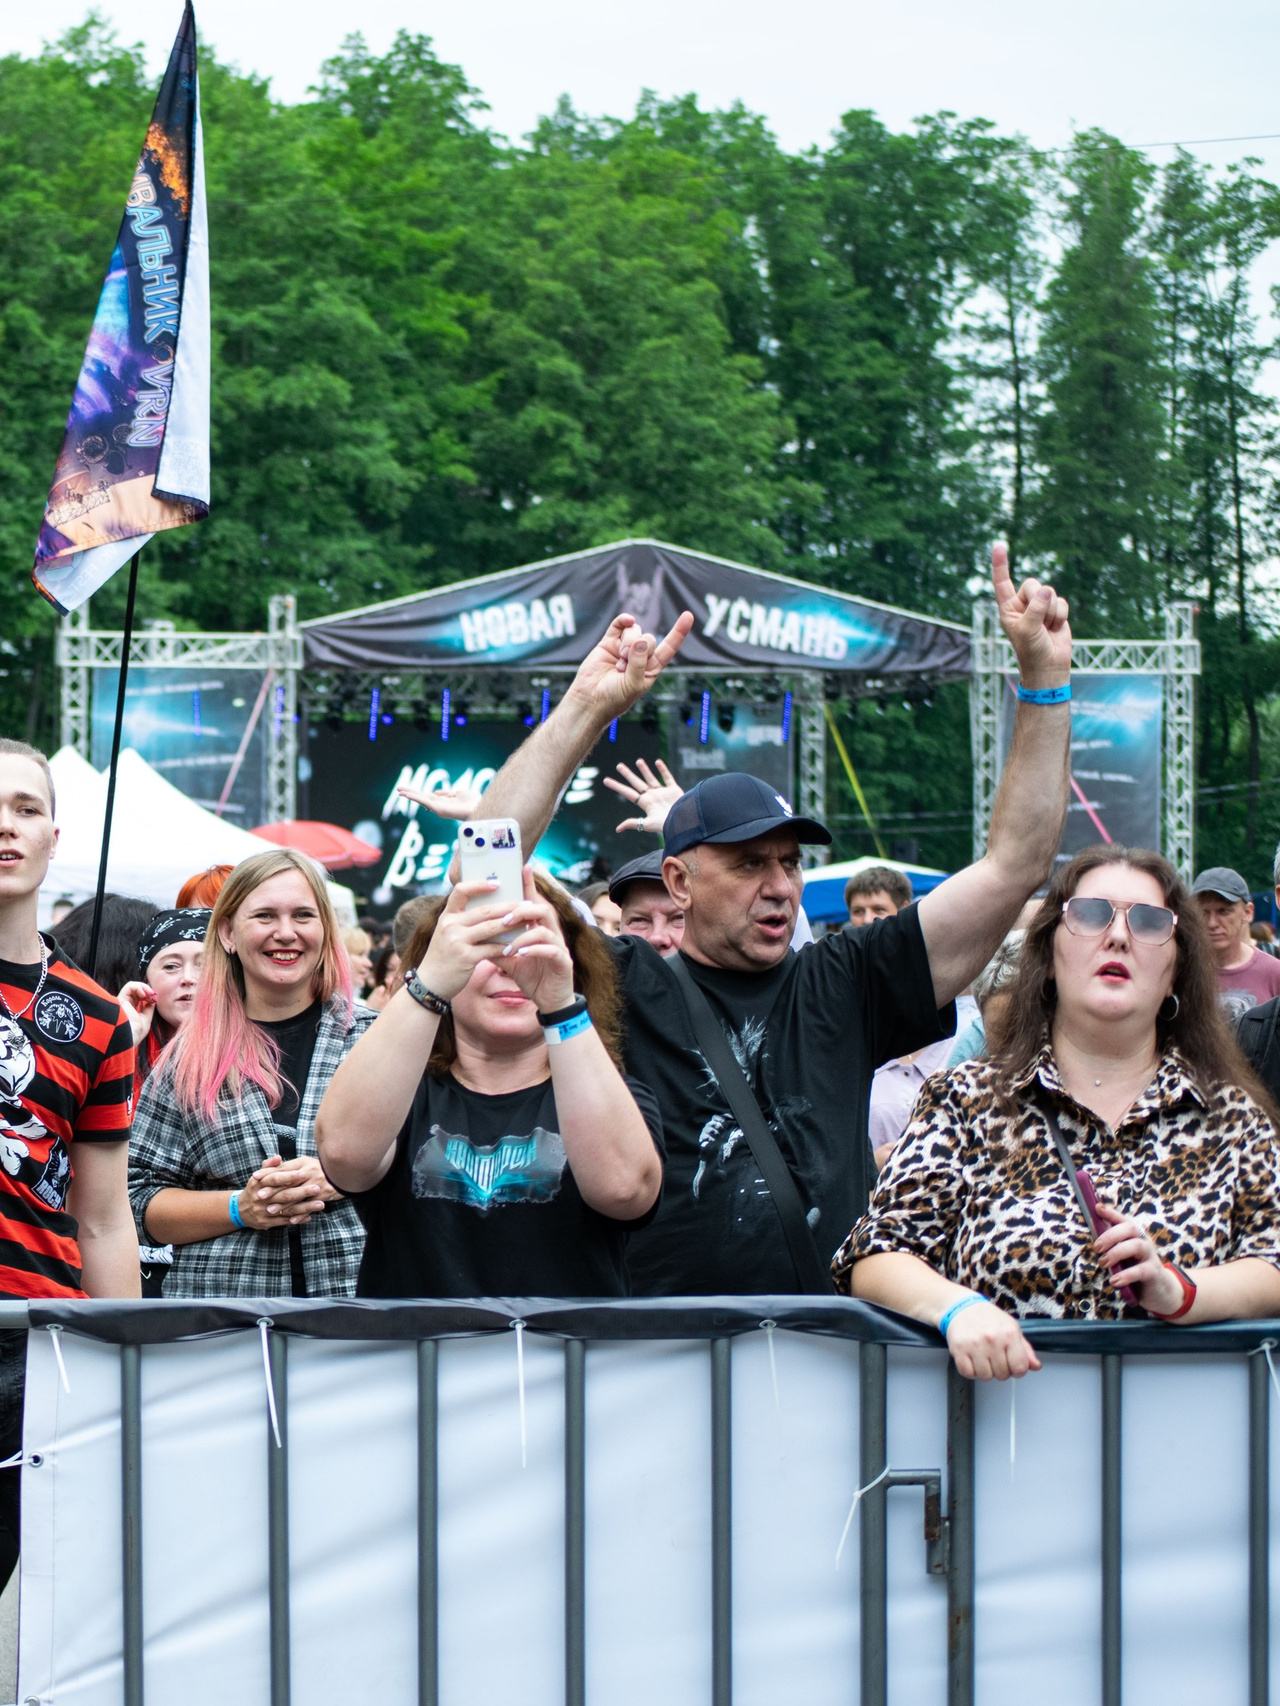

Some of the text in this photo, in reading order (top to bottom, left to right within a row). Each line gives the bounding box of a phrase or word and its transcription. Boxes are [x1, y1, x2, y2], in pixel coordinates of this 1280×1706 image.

[127, 361, 174, 446] VRN
[460, 593, 848, 660] НОВАЯ УСМАНЬ
